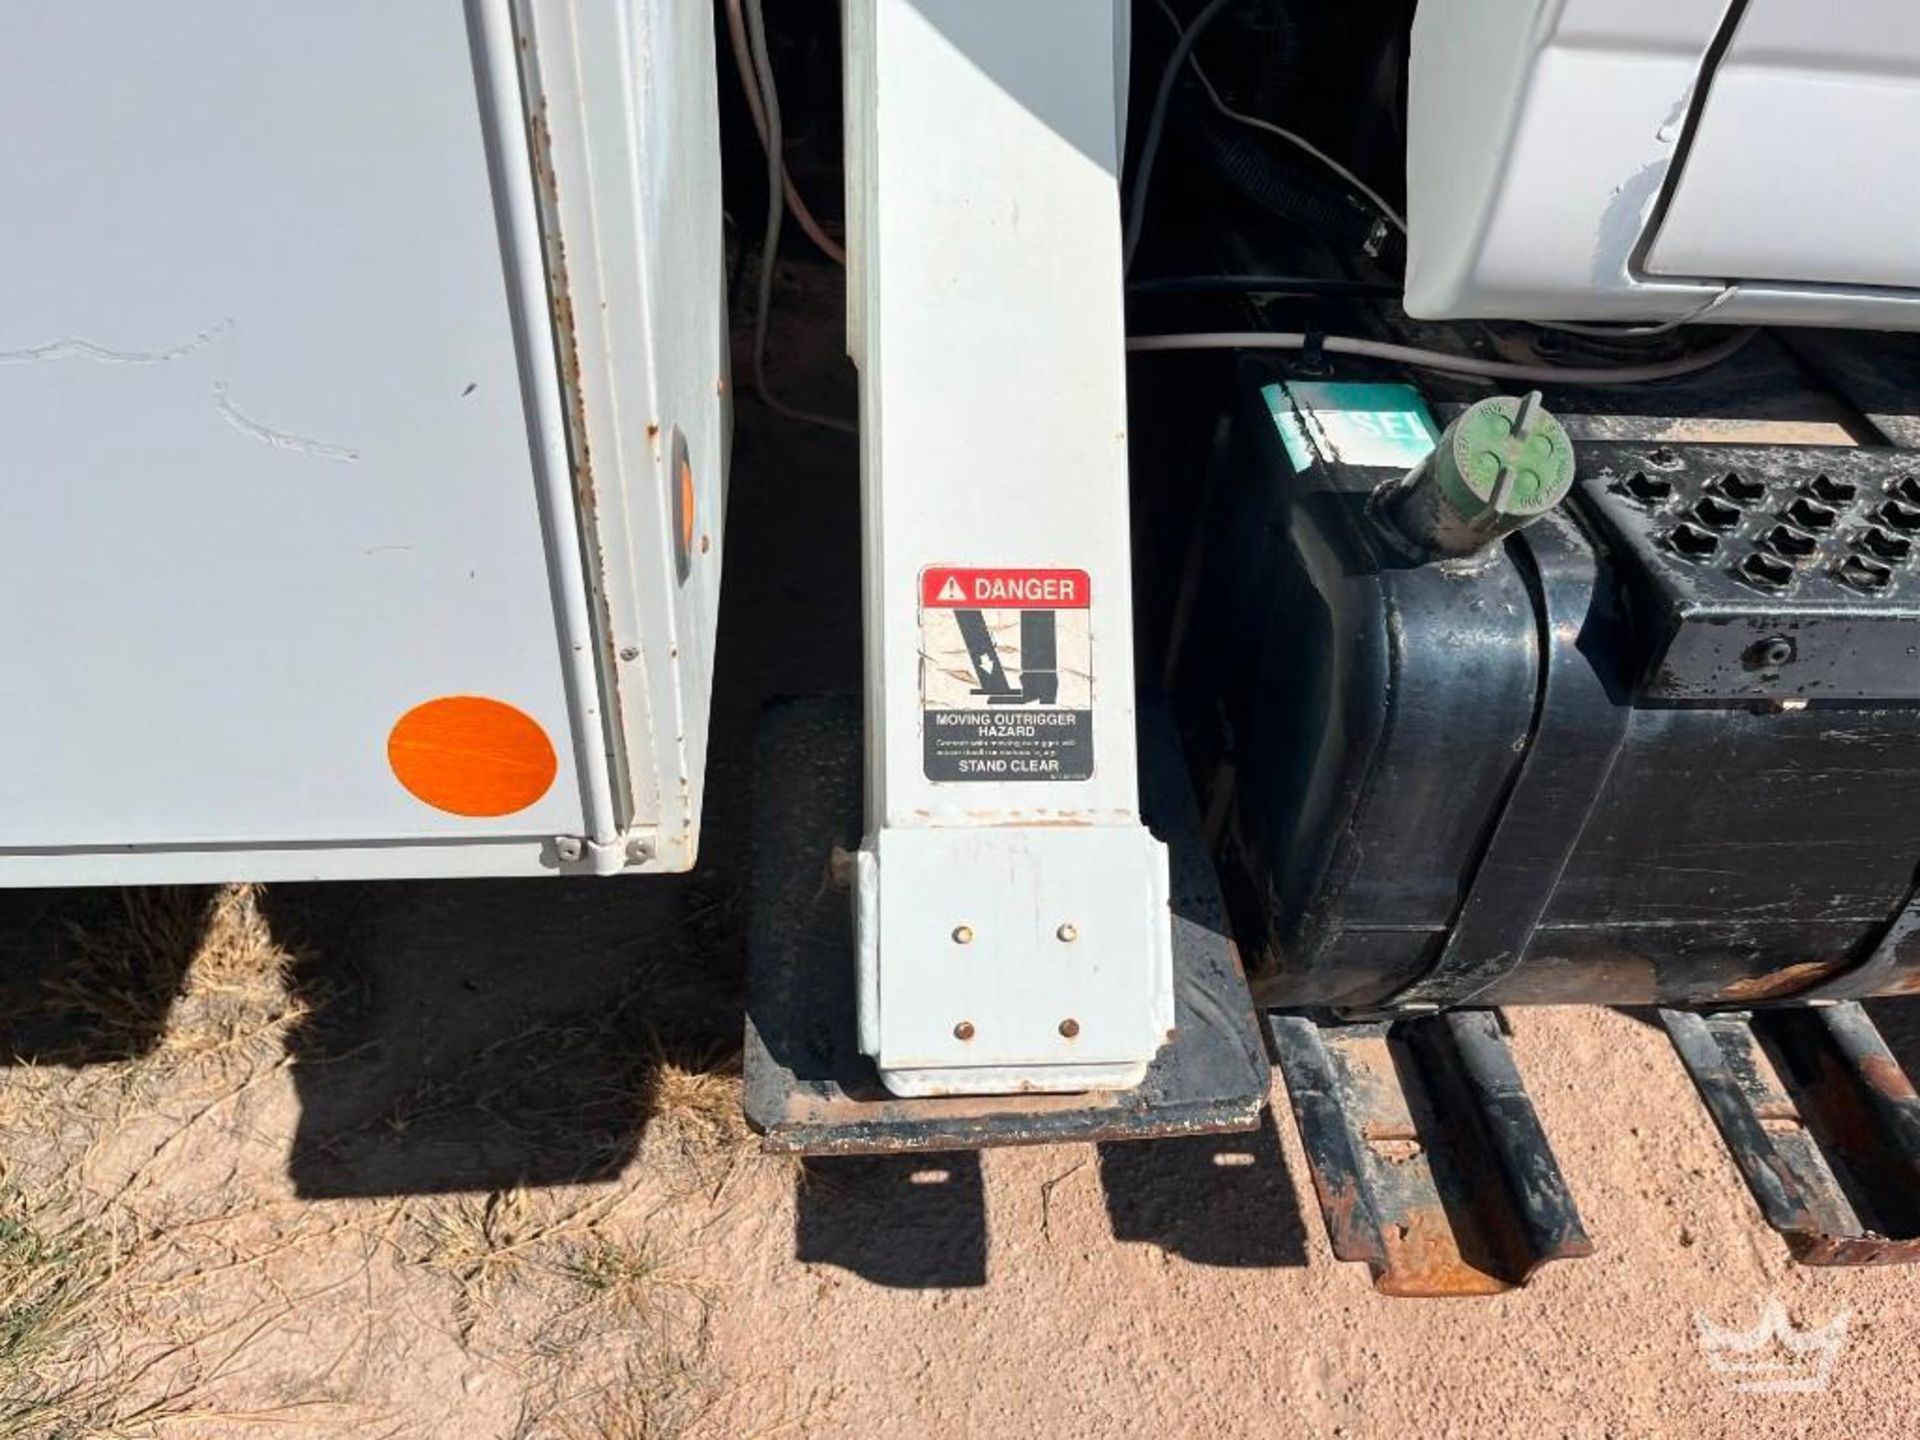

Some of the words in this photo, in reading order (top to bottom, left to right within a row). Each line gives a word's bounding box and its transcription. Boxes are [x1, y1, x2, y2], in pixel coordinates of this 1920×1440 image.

[974, 578, 1075, 600] DANGER
[935, 713, 991, 726] MOVING
[994, 713, 1077, 726] OUTRIGGER
[978, 726, 1036, 737] HAZARD
[958, 760, 1007, 772] STAND
[1010, 760, 1060, 772] CLEAR
